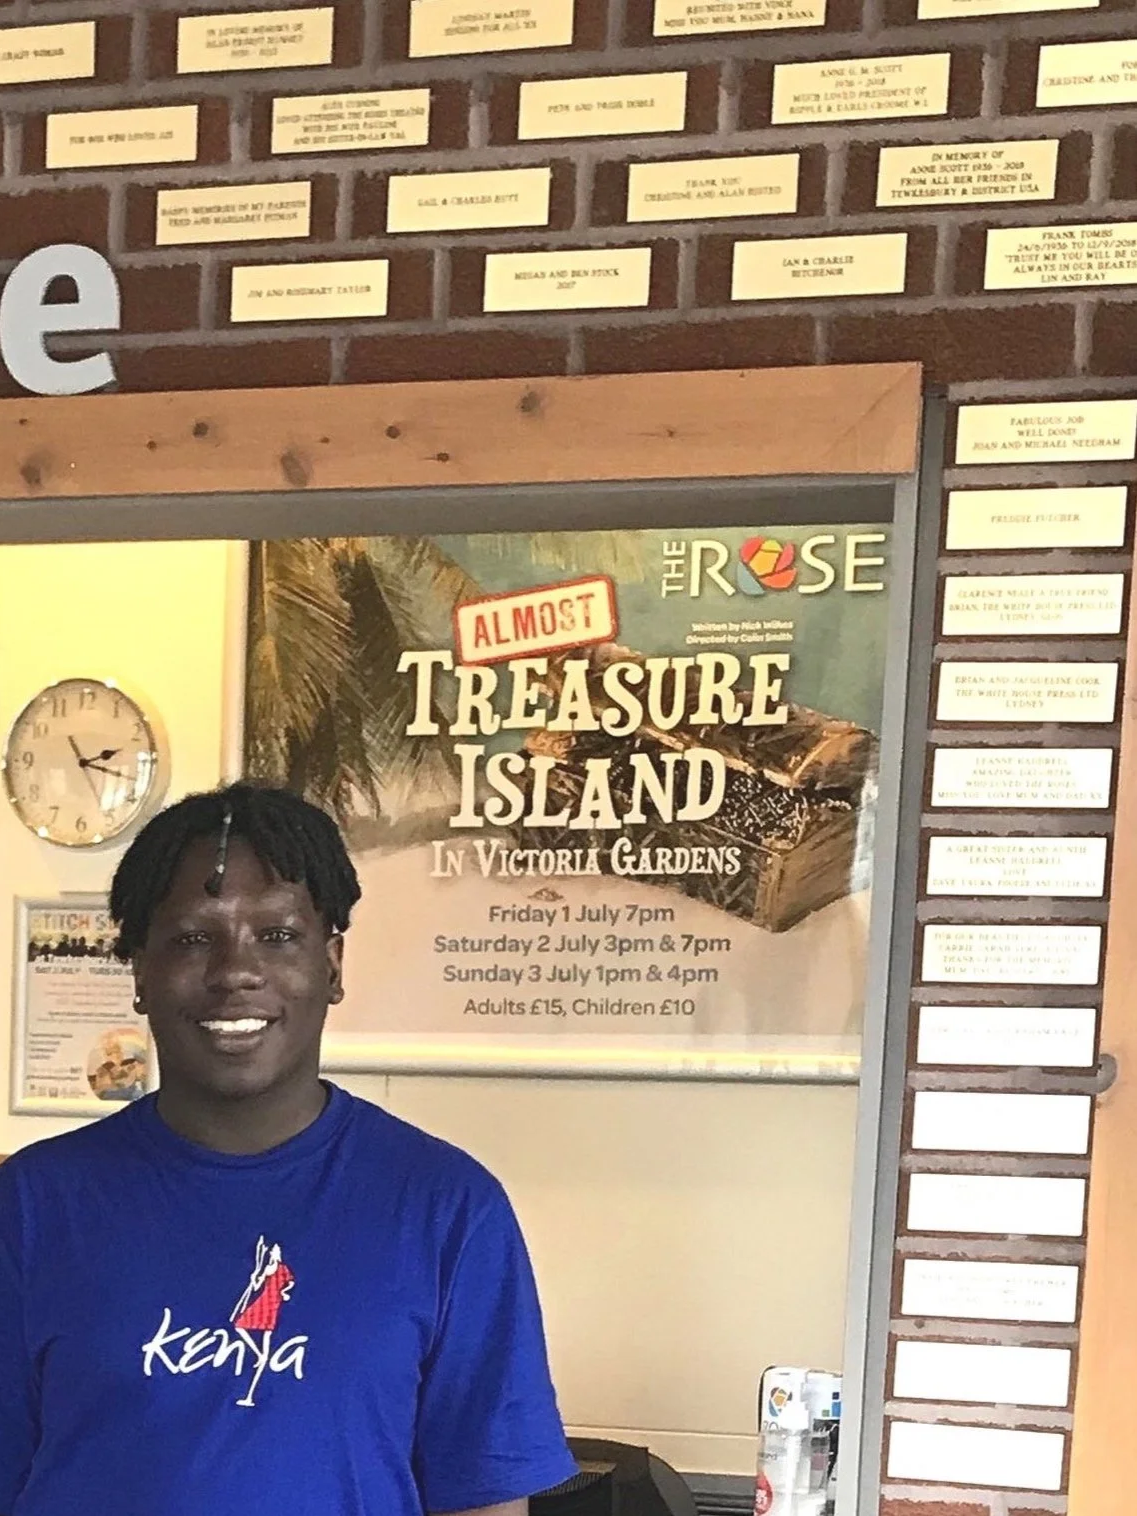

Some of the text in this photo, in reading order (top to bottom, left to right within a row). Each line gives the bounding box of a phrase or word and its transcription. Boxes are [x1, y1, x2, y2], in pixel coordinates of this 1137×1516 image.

[873, 65, 904, 74] SCOTT
[1099, 74, 1120, 83] AND
[823, 91, 857, 100] LOVED
[859, 88, 912, 98] PRESIDENT
[914, 86, 928, 95] OF
[931, 150, 1004, 162] IN MEMORY OF
[910, 163, 970, 175] ANNE SCOTT
[900, 171, 1034, 187] FROM ALL HER FRIENDS IN
[695, 189, 715, 199] AND
[719, 187, 745, 197] ALAN
[890, 187, 957, 198] TEWKESBURY
[971, 185, 1016, 195] DISTRICT
[1020, 183, 1040, 193] USA
[1041, 230, 1077, 240] FRANK
[1071, 240, 1085, 249] TO
[1043, 249, 1128, 261] ME YOU WILL BE
[1013, 259, 1137, 274] ALWAYS IN OUR HEARTS
[549, 269, 569, 279] AND
[1040, 270, 1107, 283] LIN AND RAY
[266, 289, 285, 297] AND
[1010, 416, 1085, 427] FABULOUS JOB
[1017, 428, 1044, 437] WELL
[972, 438, 1122, 451] JOAN AND MICHAEL NEEDHAM
[662, 541, 686, 598] THE
[982, 603, 1032, 612] THE WHITE
[473, 593, 597, 650] ALMOST
[954, 676, 985, 686] BRIAN
[989, 676, 1010, 685] AND
[397, 651, 791, 738] TREASURE
[955, 689, 1100, 699] THE WHITE HOUSE PRESS LTD
[51, 690, 123, 719] 11 12 1
[1005, 700, 1044, 709] LYDNEY
[32, 722, 49, 740] 10
[22, 751, 35, 771] 9
[28, 783, 40, 802] 8
[449, 744, 727, 831] ISLAND
[49, 805, 60, 825] 7
[74, 815, 87, 833] 6
[430, 836, 742, 879] IN VICTORIA GARDENS
[488, 904, 675, 927] Friday 1 July 7pm
[433, 934, 733, 957] Saturday 2 July 3pm & 7pm
[442, 964, 720, 988] Sunday 3 July 1pm & 4pm
[463, 998, 696, 1018] Adults £15, Children £10
[141, 1306, 310, 1408] Kenya
